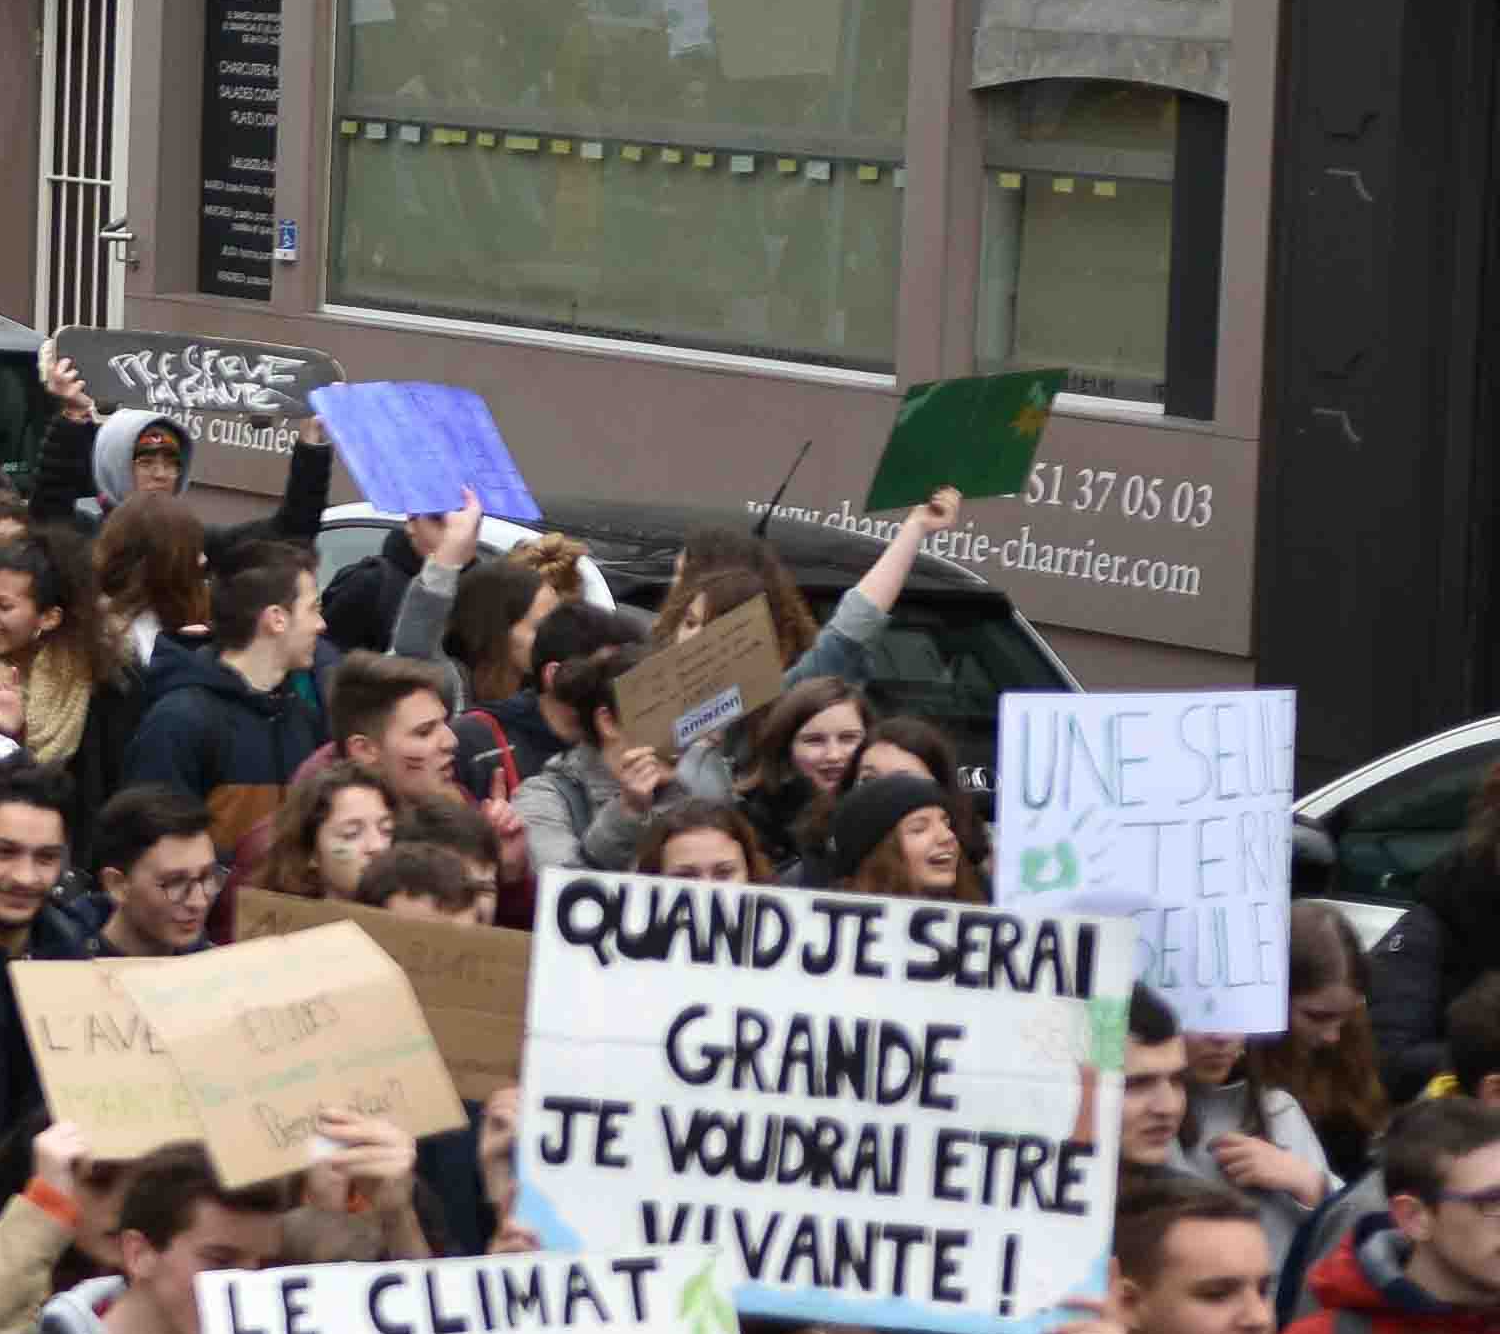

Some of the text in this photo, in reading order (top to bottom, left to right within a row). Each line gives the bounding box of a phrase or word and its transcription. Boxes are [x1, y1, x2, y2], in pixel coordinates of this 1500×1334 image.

[1025, 462, 1215, 529] 51 37 05 03
[680, 694, 740, 739] amazon
[1022, 711, 1153, 811] UNE
[556, 876, 1097, 1000] QUAND JE SERAI
[664, 1004, 967, 1113] GRANDE
[539, 1093, 1096, 1216] JE VOUDRAI ETRE
[640, 1199, 973, 1305] VIVANTE
